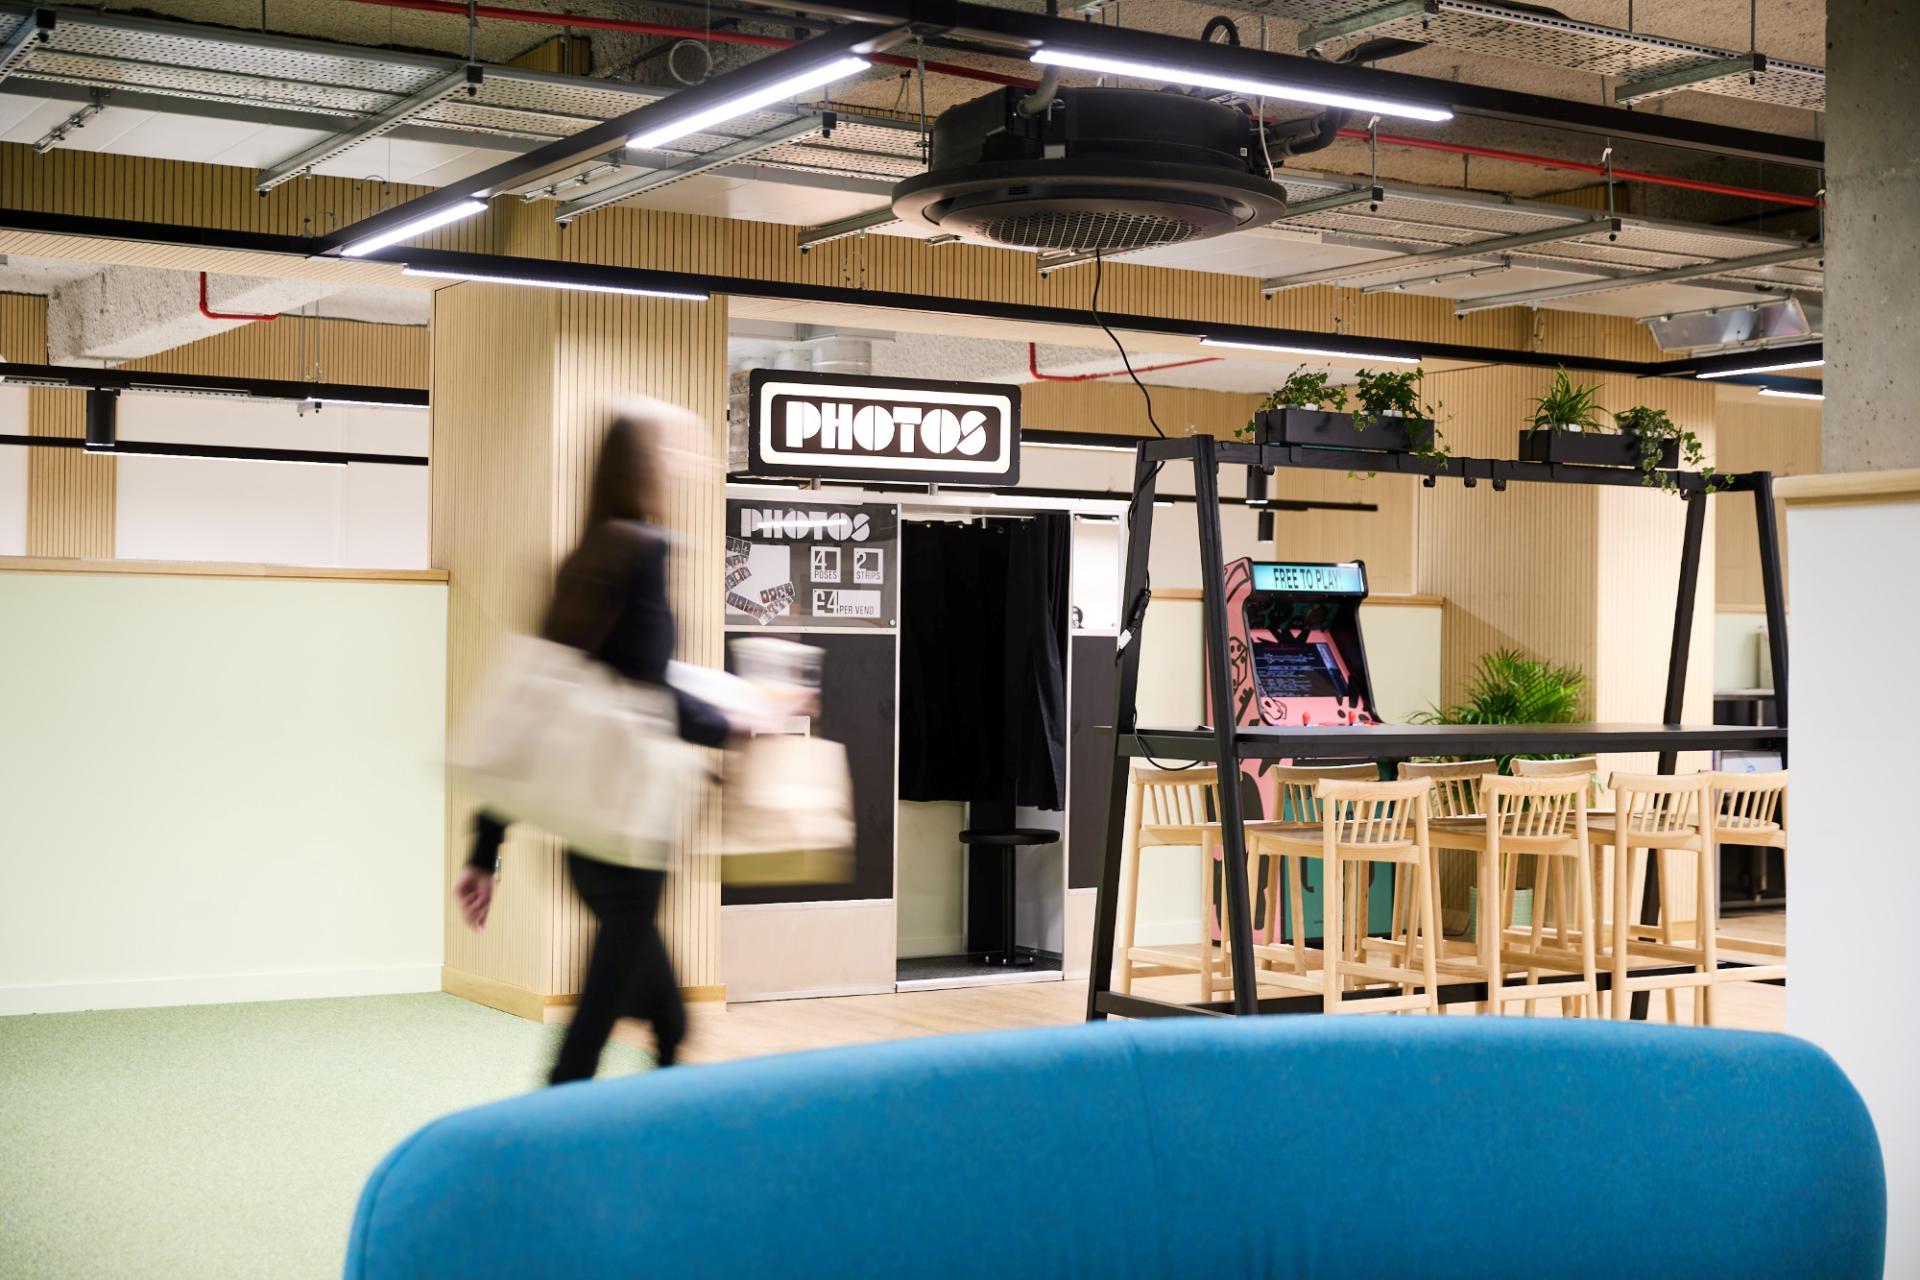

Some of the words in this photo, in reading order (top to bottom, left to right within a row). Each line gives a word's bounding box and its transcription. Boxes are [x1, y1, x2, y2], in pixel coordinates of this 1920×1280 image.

[786, 401, 987, 455] PHOTOS
[741, 508, 870, 542] PHOTOS
[814, 551, 827, 570] 4
[856, 552, 867, 571] 2
[814, 571, 838, 580] POSES
[856, 571, 881, 581] STRIPS
[1273, 568, 1299, 589] FREE
[1300, 569, 1313, 590] TO
[814, 590, 839, 614] £4
[839, 605, 853, 615] PER
[855, 606, 874, 615] VEND
